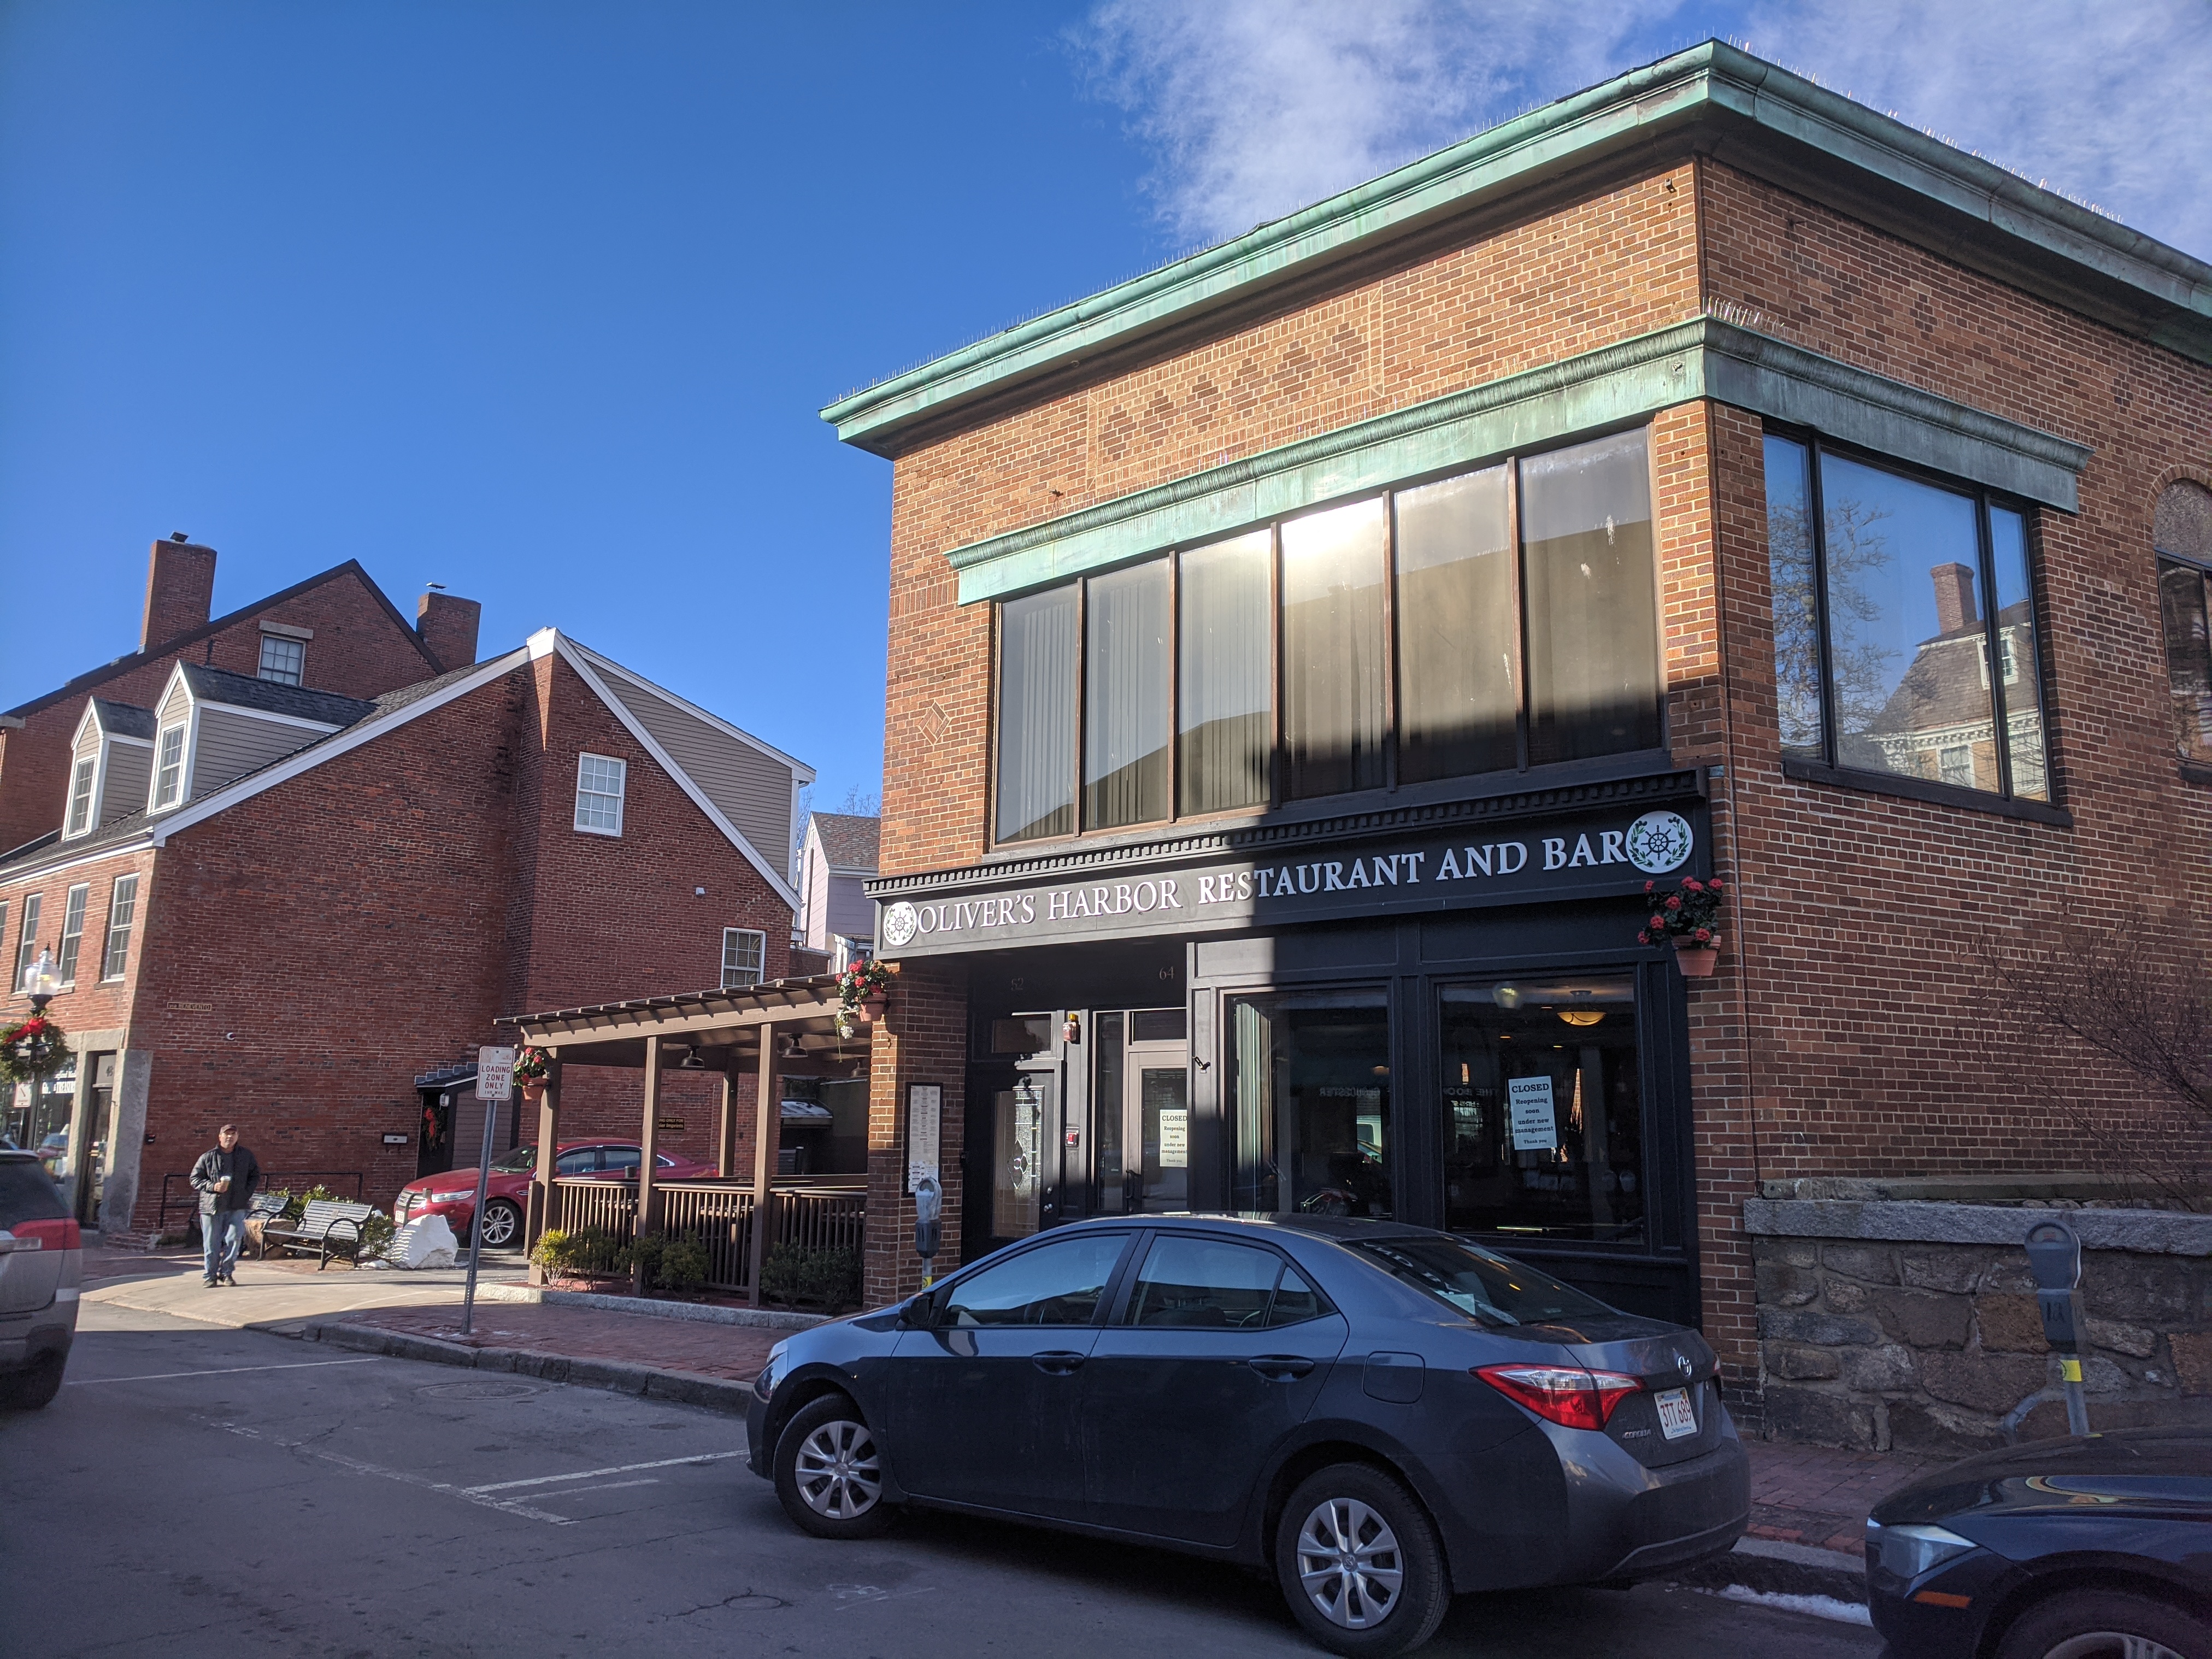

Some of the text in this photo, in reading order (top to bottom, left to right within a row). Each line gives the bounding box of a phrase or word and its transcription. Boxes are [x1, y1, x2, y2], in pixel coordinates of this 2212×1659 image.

[918, 831, 1628, 934] OLIVER'S HARBOR RESTAURANT AND BAR
[1158, 966, 1175, 980] 64
[481, 1065, 510, 1073] LOADING
[1511, 1083, 1549, 1093] CLOSED
[1515, 1126, 1554, 1134] management
[1660, 1399, 1691, 1428] 3TT 689
